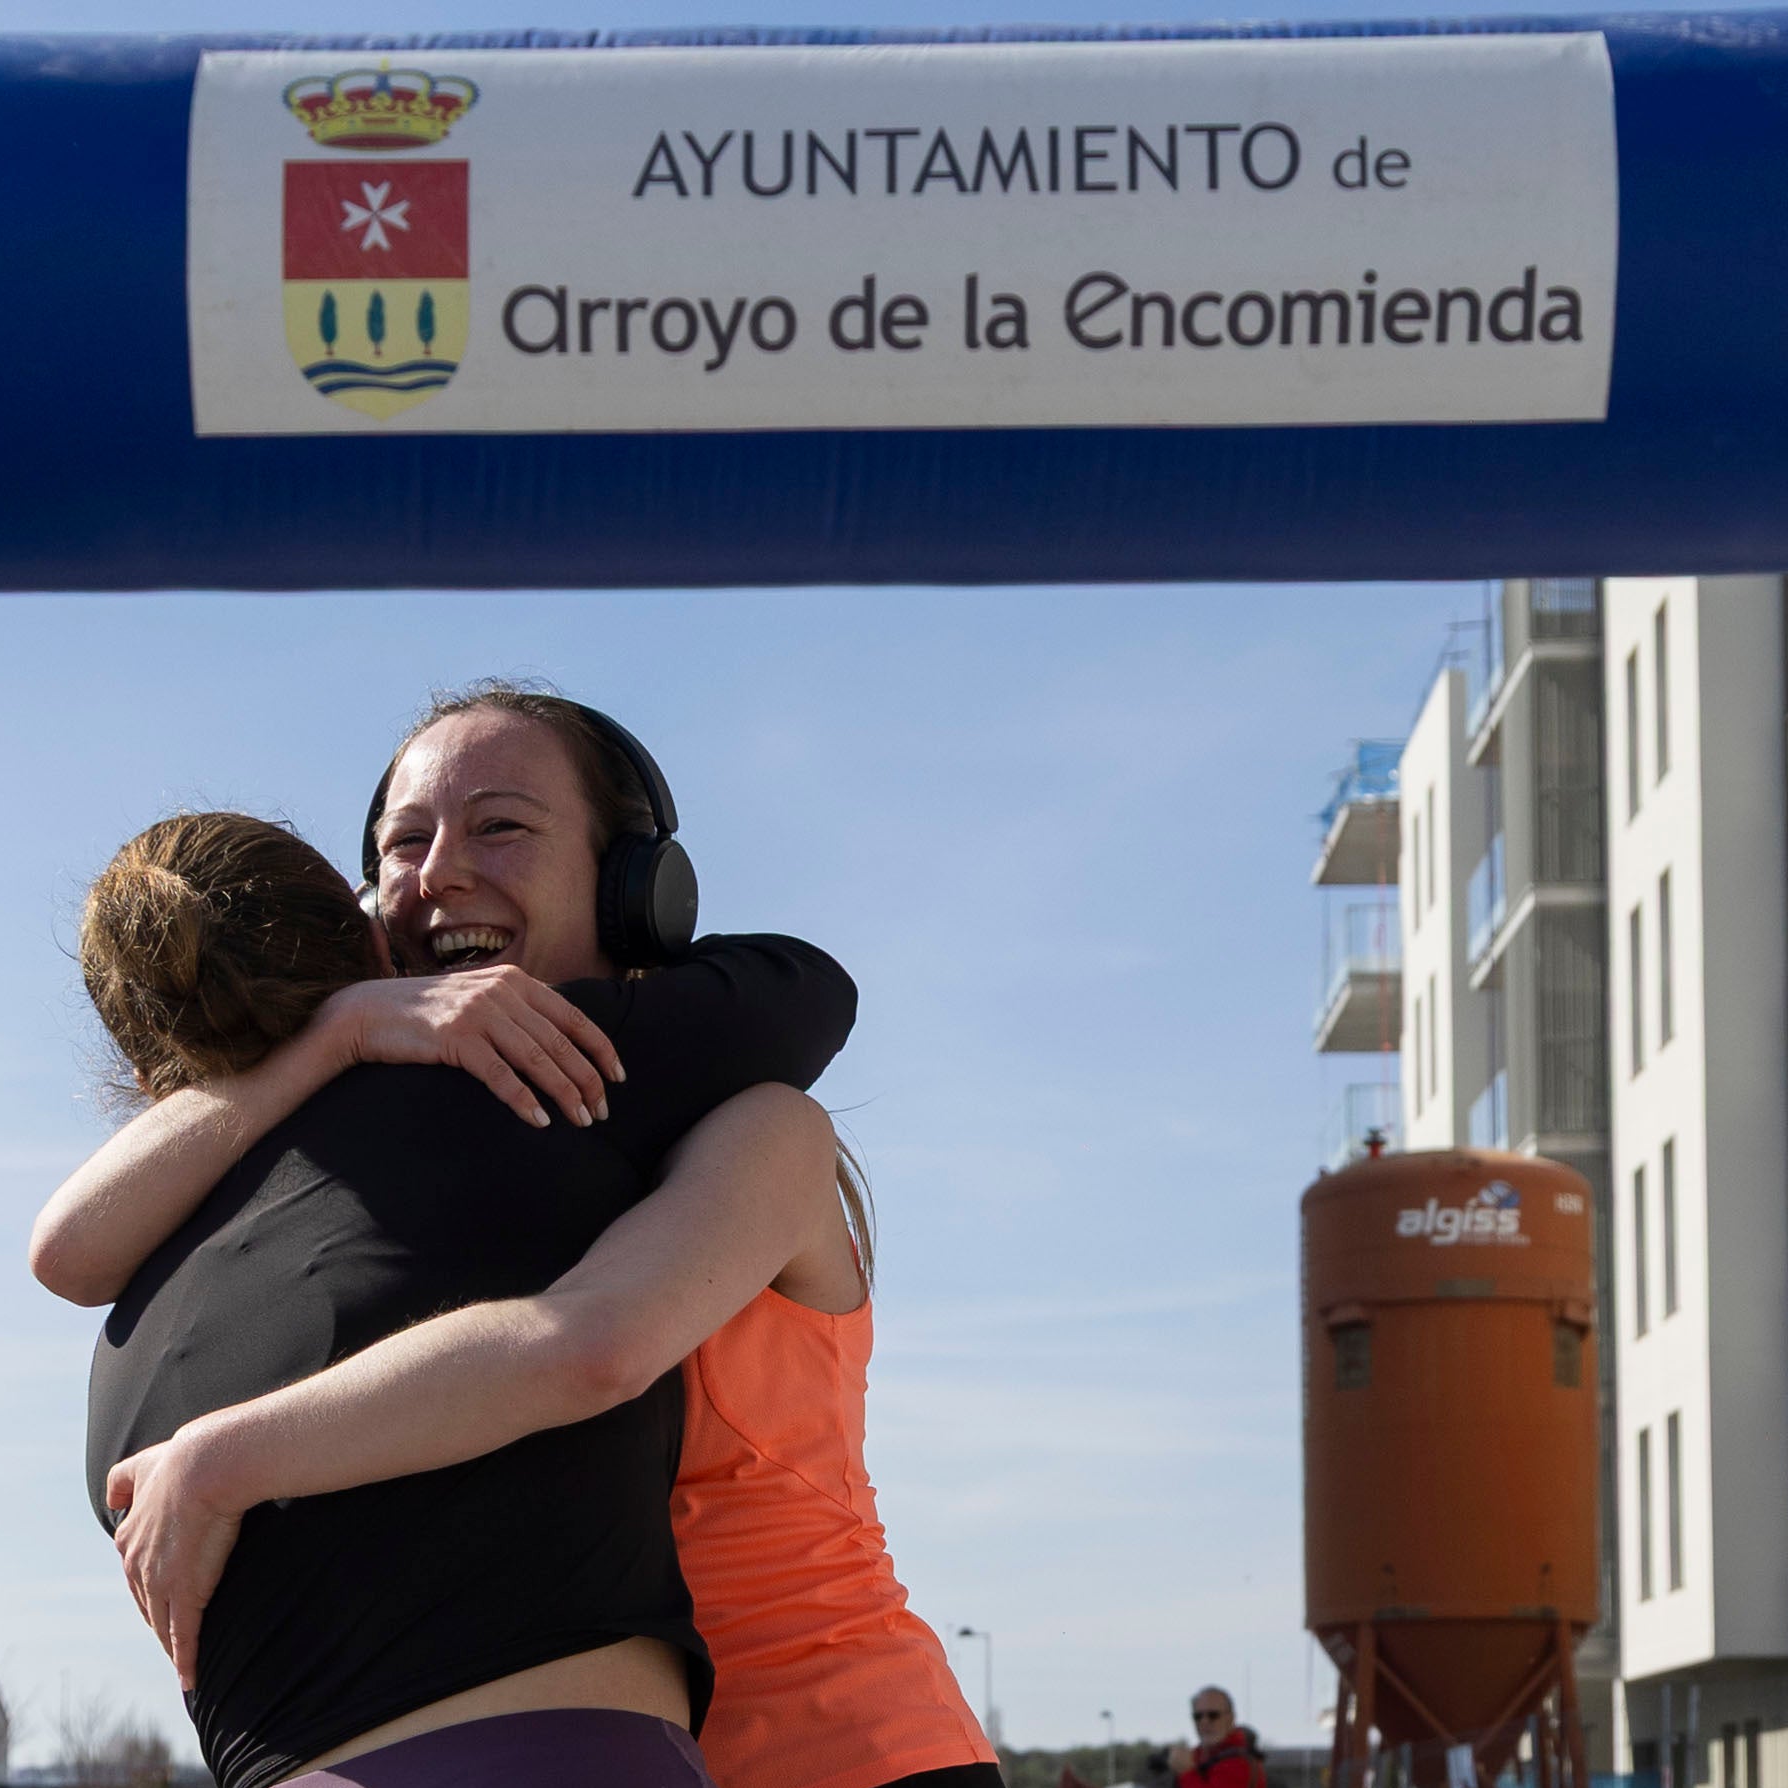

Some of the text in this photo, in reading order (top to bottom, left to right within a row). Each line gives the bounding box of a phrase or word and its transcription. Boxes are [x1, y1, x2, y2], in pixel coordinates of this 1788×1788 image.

[633, 121, 1412, 198] AYUNTAMIENTO de
[828, 273, 930, 351] de
[964, 272, 1030, 350] la
[1395, 1197, 1522, 1245] algiss
